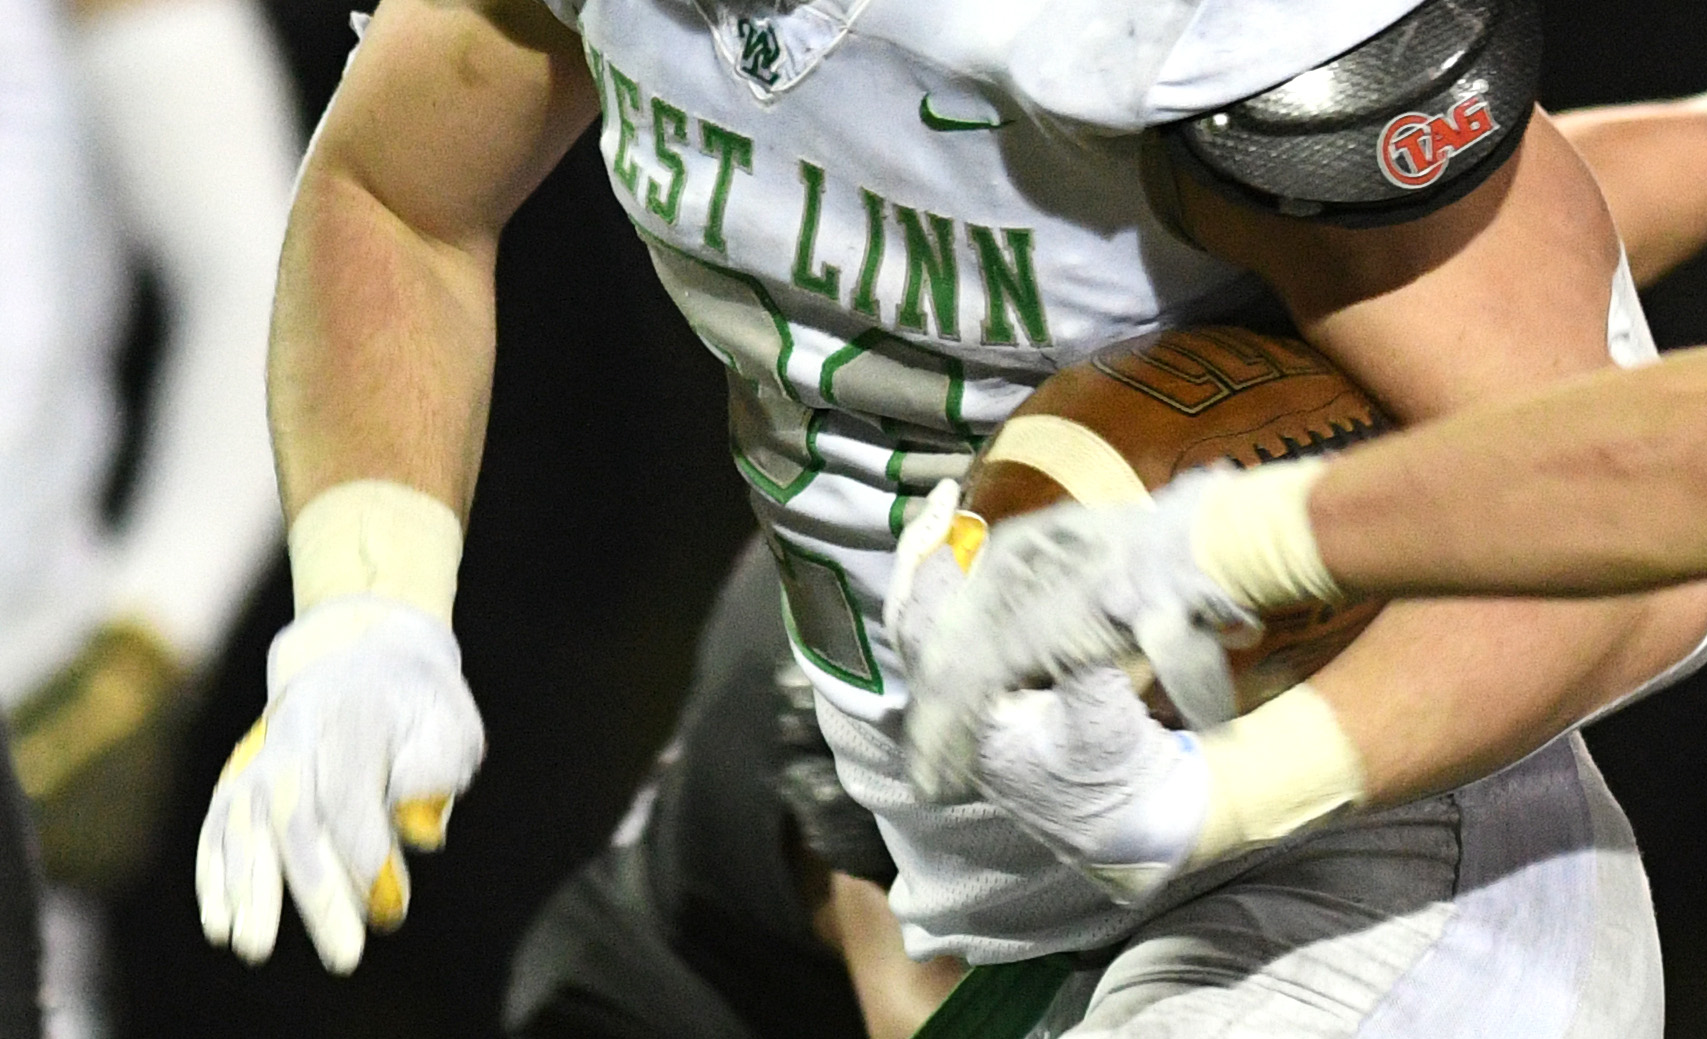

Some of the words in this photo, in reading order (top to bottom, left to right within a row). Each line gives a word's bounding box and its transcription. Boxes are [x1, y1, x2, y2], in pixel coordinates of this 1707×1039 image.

[584, 46, 754, 253] EST
[792, 158, 1053, 348] LINN
[1386, 93, 1498, 179] TAG
